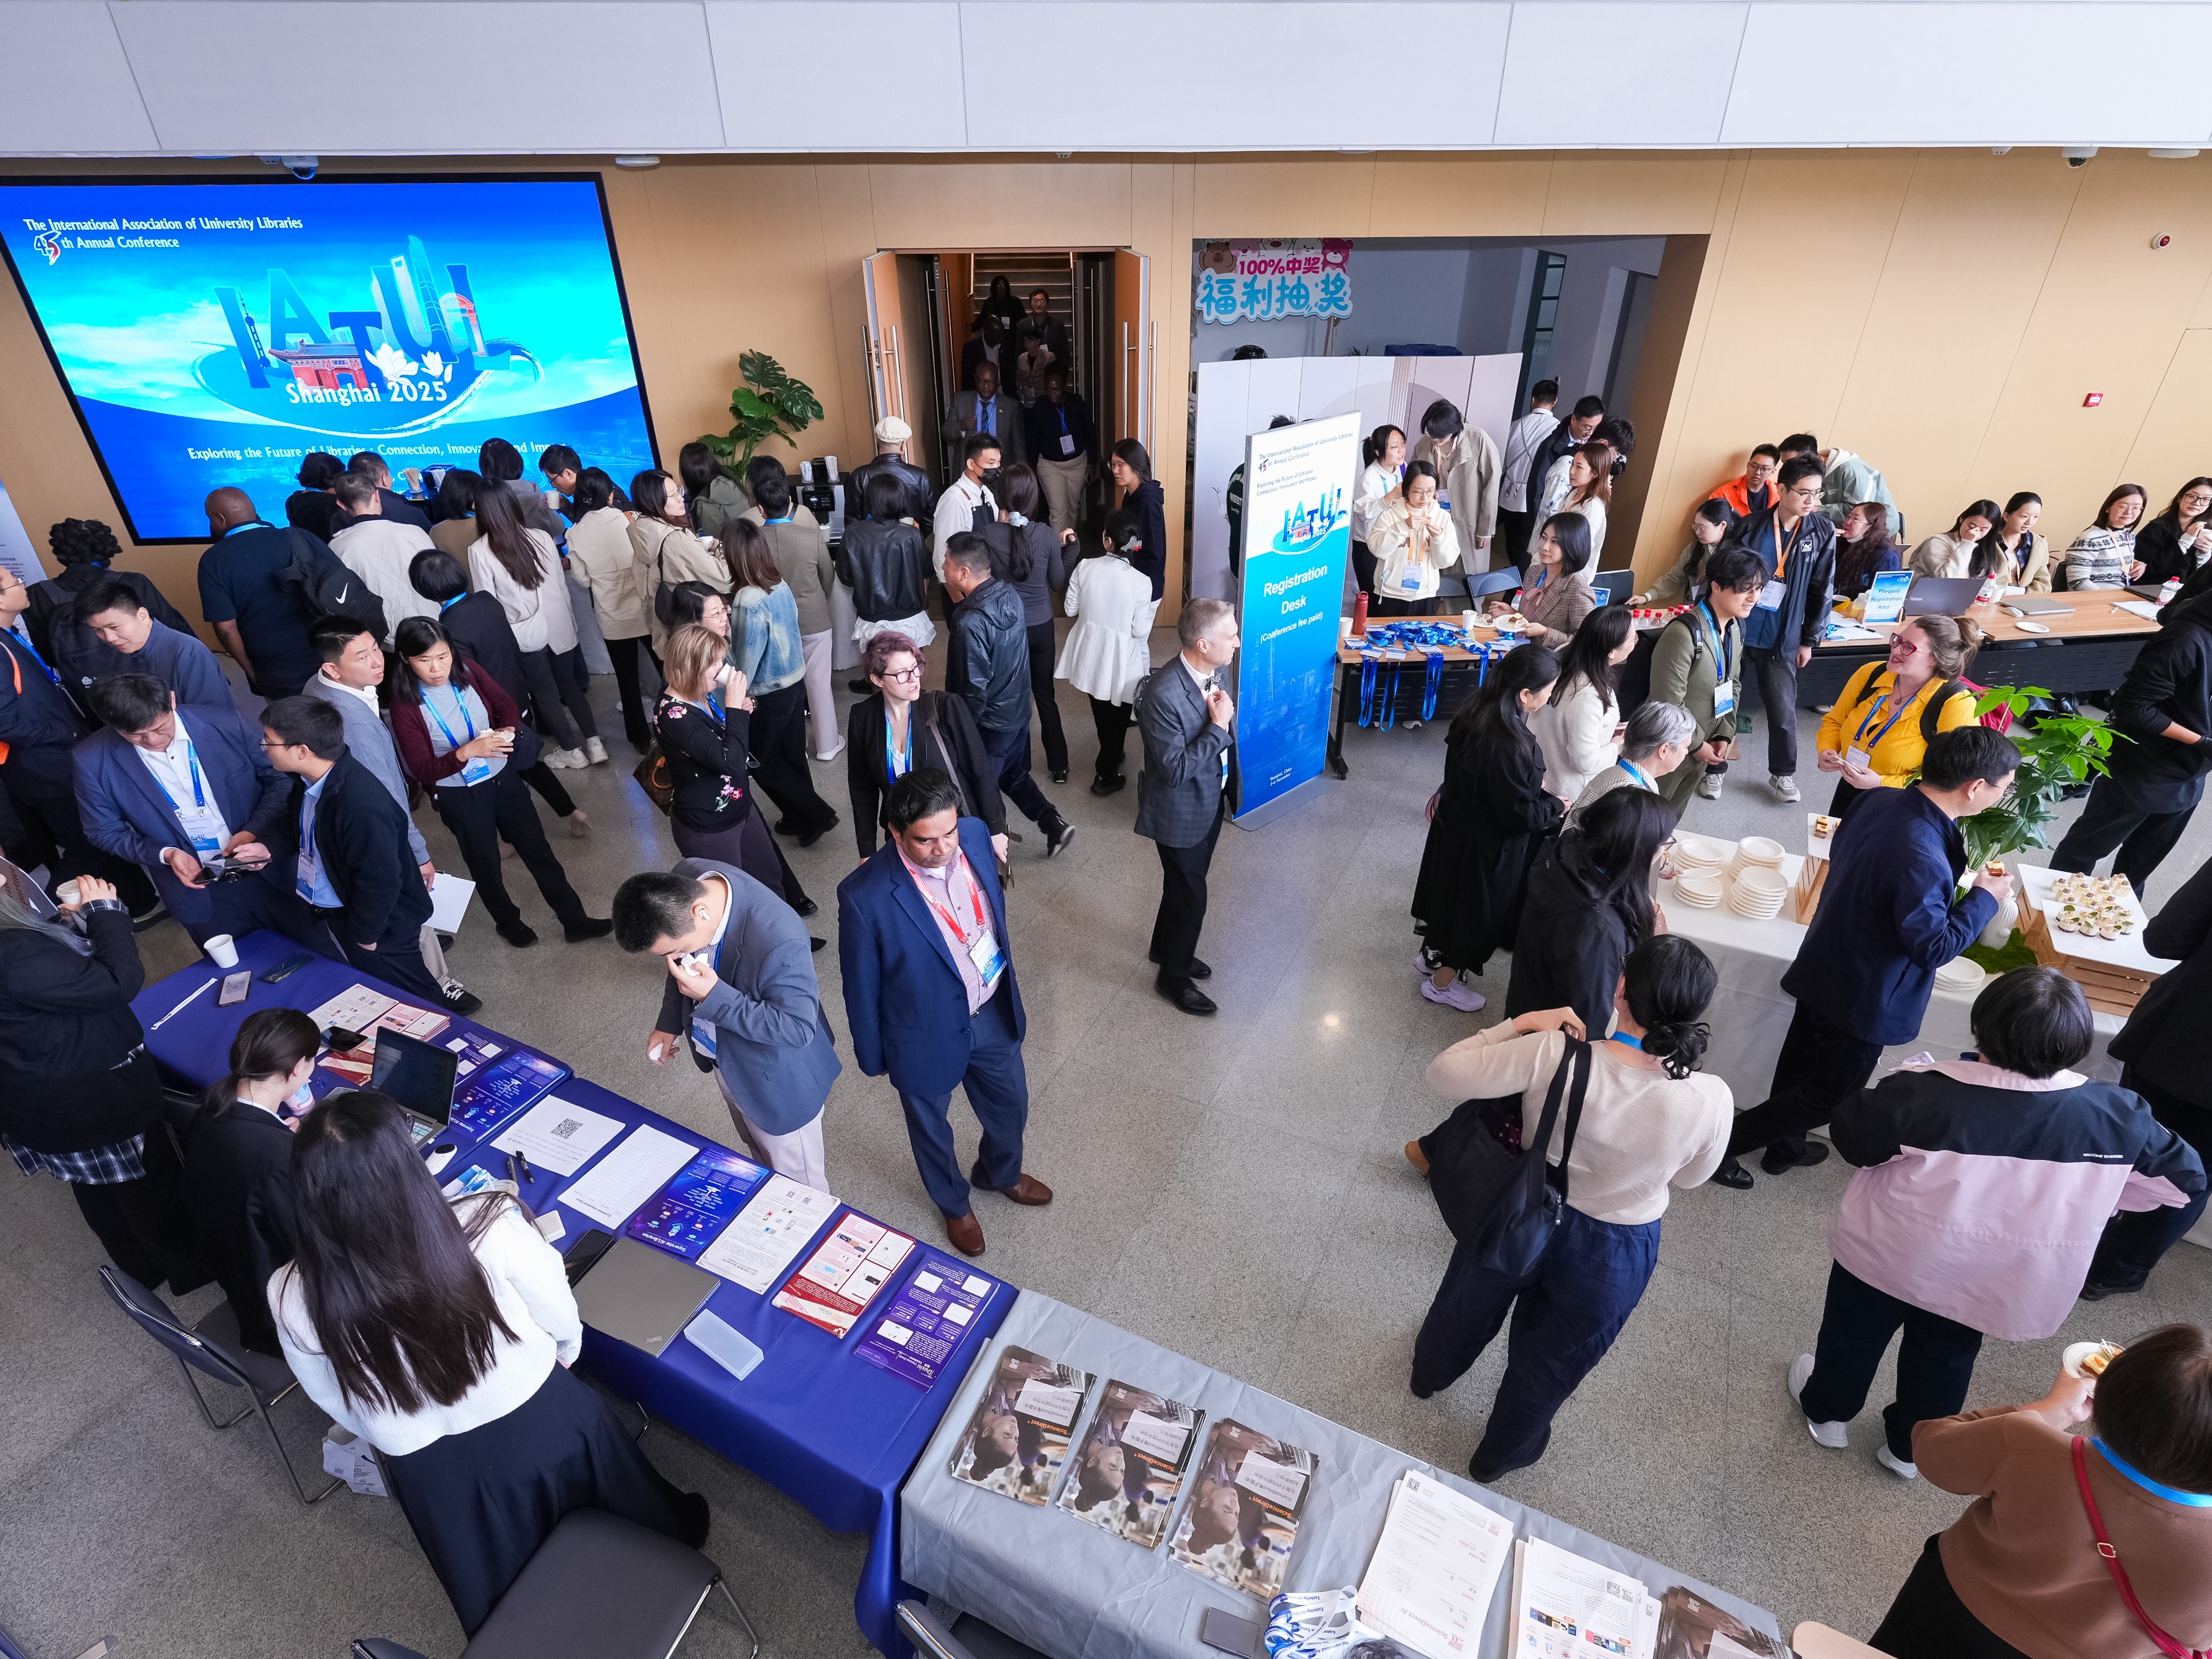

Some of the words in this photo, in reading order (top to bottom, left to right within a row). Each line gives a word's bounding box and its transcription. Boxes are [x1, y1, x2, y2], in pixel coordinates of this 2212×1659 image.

[23, 218, 47, 231] The
[49, 218, 118, 231] International
[122, 218, 182, 230] Association
[185, 217, 197, 230] of
[201, 217, 254, 231] University
[256, 217, 304, 230] Libraries
[34, 230, 61, 266] 45
[61, 237, 74, 249] th
[77, 236, 115, 249] Annual
[117, 236, 180, 248] Conference
[1239, 256, 1321, 276] 100%中奖
[1199, 272, 1349, 316] 福利抽奖
[286, 381, 382, 407] Shanghai
[388, 381, 448, 403] 2025
[189, 447, 242, 461] Exploring
[244, 447, 263, 458] the
[265, 446, 302, 458] Future
[306, 446, 319, 457] of
[320, 445, 366, 457] Libraries
[378, 444, 444, 457] Connection,
[447, 442, 481, 455] Innova
[1267, 447, 1292, 457] International
[1293, 442, 1314, 451] Association
[1319, 436, 1338, 445] University
[1338, 432, 1354, 440] Libraries
[1258, 459, 1269, 472] 45
[1273, 457, 1288, 465] Annual
[1288, 452, 1310, 461] Conference
[1299, 469, 1313, 477] Libraries
[1279, 482, 1298, 490] Innovation
[1311, 528, 1326, 538] 2025
[1263, 564, 1328, 597] Registration
[1280, 594, 1307, 615] Desk
[1260, 622, 1298, 645] (Conference
[1298, 617, 1308, 629] fee
[1307, 611, 1323, 626] paid)
[458, 1120, 474, 1133] Superstar
[583, 1200, 597, 1210] Intention
[596, 1207, 611, 1217] Customer
[641, 1231, 660, 1243] Librarian
[665, 1239, 687, 1252] Superstar
[645, 1334, 662, 1344] ThinkPad
[916, 1363, 933, 1377] Duxiu
[1400, 1607, 1408, 1615] AI
[1407, 1610, 1448, 1640] ScienceDirect
